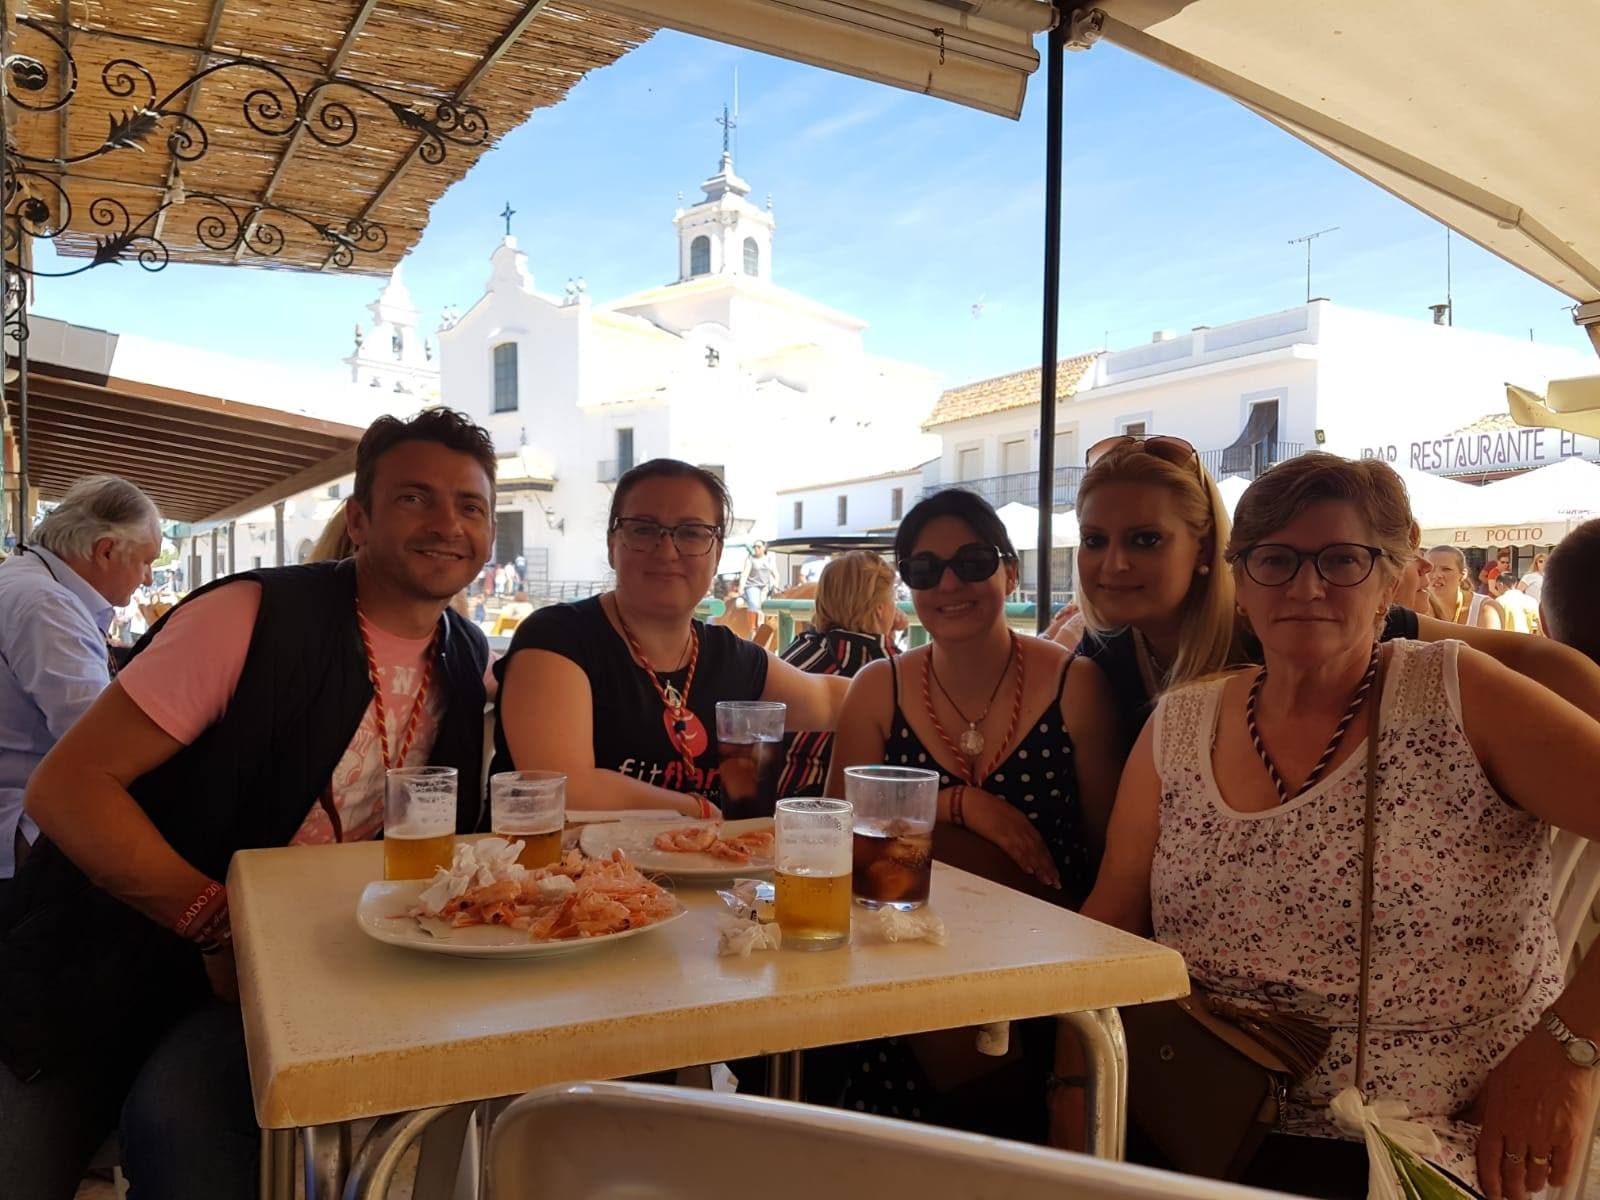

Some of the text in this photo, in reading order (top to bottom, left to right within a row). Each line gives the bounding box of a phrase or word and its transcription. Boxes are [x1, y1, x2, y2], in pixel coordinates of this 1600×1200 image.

[1410, 428, 1545, 470] RESTAURANTE
[1560, 429, 1583, 457] EL
[1454, 527, 1543, 543] EL POCITO
